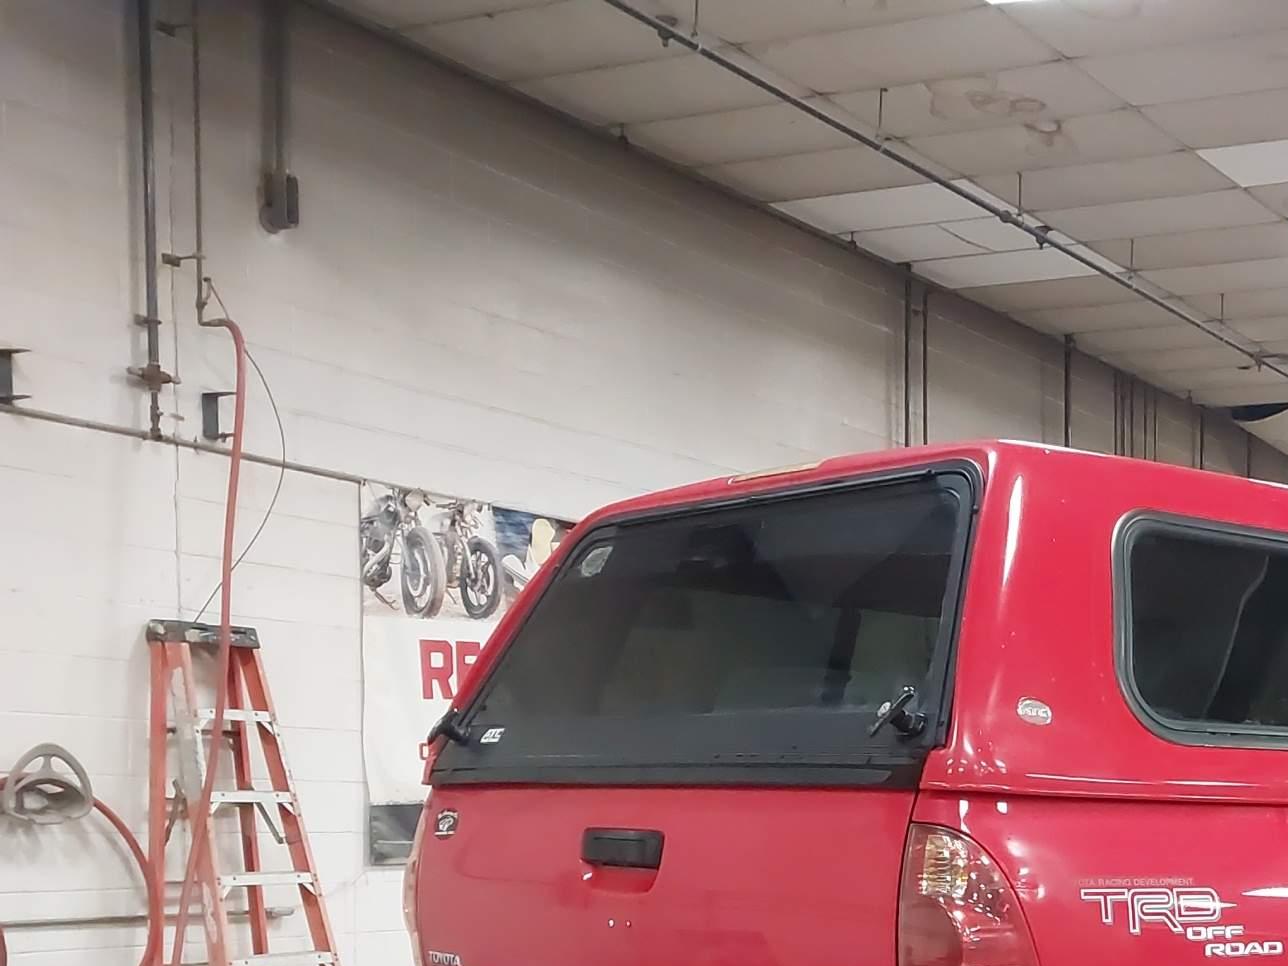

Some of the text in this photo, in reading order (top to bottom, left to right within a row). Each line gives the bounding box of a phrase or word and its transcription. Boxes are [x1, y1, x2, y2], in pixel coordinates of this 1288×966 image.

[1133, 878, 1194, 886] DEVELOPMENT
[1080, 887, 1222, 935] TRD
[1186, 926, 1245, 940] OFF
[1205, 942, 1283, 956] ROAD
[428, 951, 462, 966] TOYOTA
